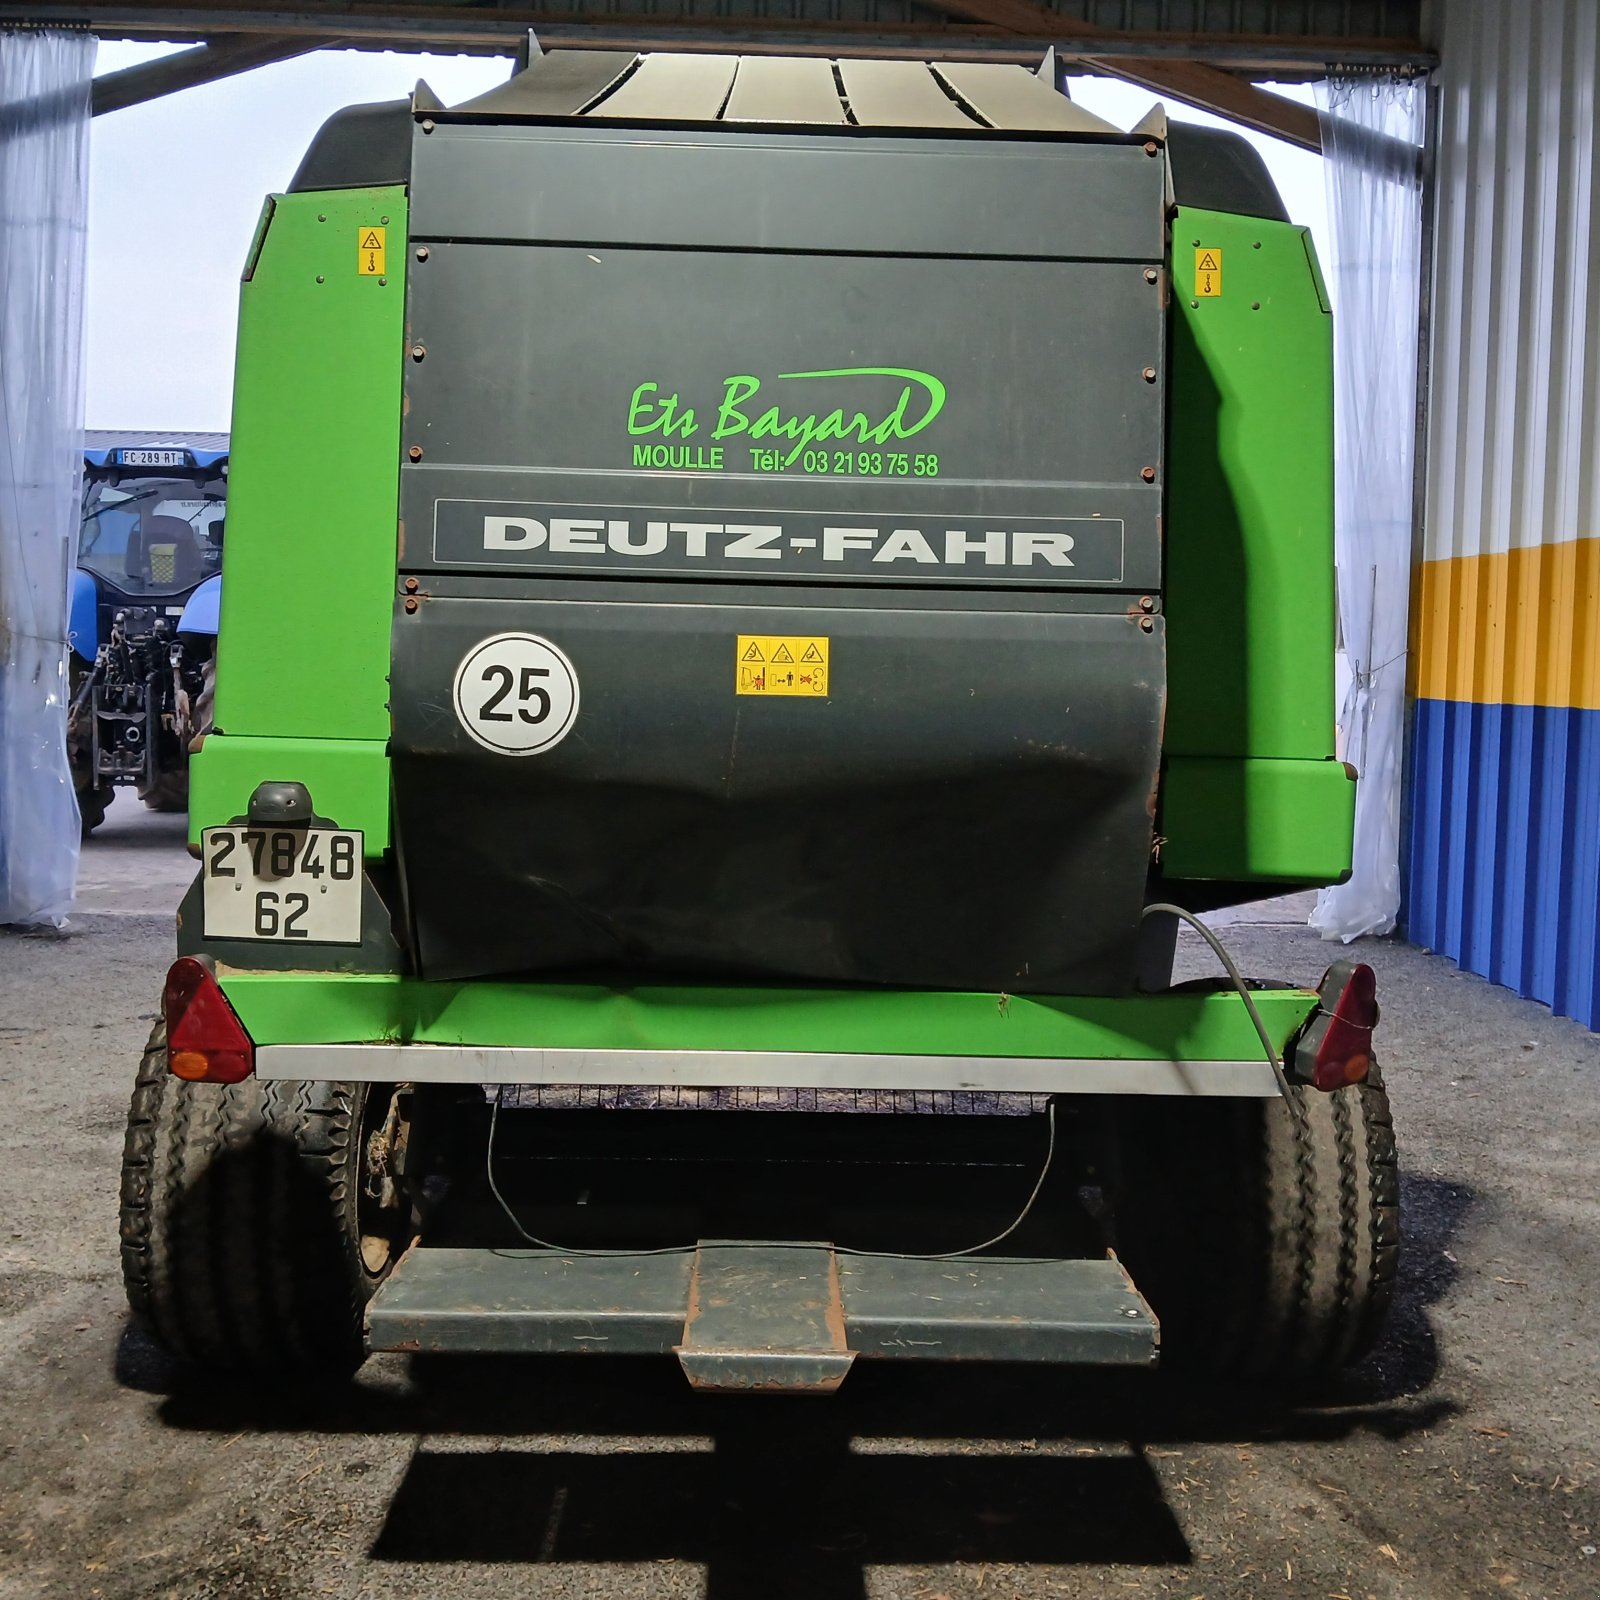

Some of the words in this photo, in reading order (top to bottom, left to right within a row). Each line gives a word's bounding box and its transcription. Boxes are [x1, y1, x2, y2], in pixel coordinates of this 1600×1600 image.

[627, 381, 699, 439] Ets
[710, 366, 946, 464] Bayard
[632, 444, 725, 469] MOULLE
[749, 448, 786, 472] Tél:
[803, 450, 829, 473] 03
[833, 451, 853, 474] 21
[857, 452, 882, 475] 93
[886, 453, 909, 476] 75
[913, 453, 939, 477] 58
[482, 515, 1076, 568] DEUTZ-FAHR
[478, 664, 552, 725] 25
[210, 832, 354, 880] 27848
[254, 891, 309, 937] 62
